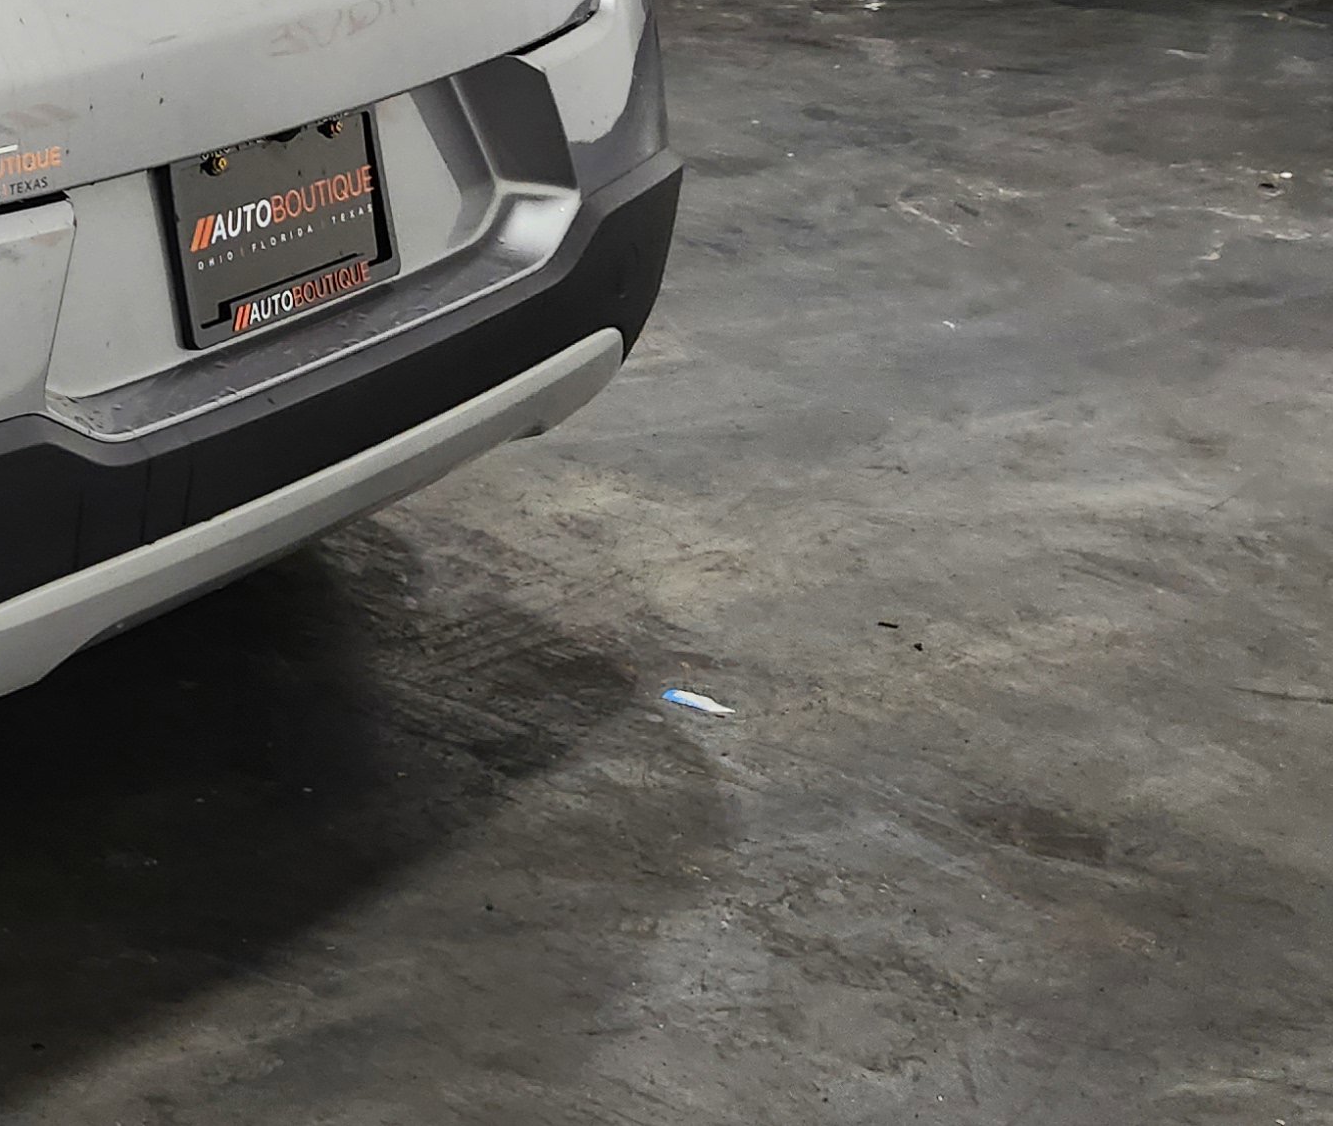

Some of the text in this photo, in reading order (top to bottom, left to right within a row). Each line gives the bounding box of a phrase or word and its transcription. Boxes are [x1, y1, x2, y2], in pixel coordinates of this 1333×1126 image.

[9, 176, 49, 196] TEXAS
[211, 164, 375, 245] AUTOBOUTIQUE
[197, 203, 373, 271] OHIO FLORIDA TEXAS
[249, 260, 372, 324] AUTOBOUTIQUE
